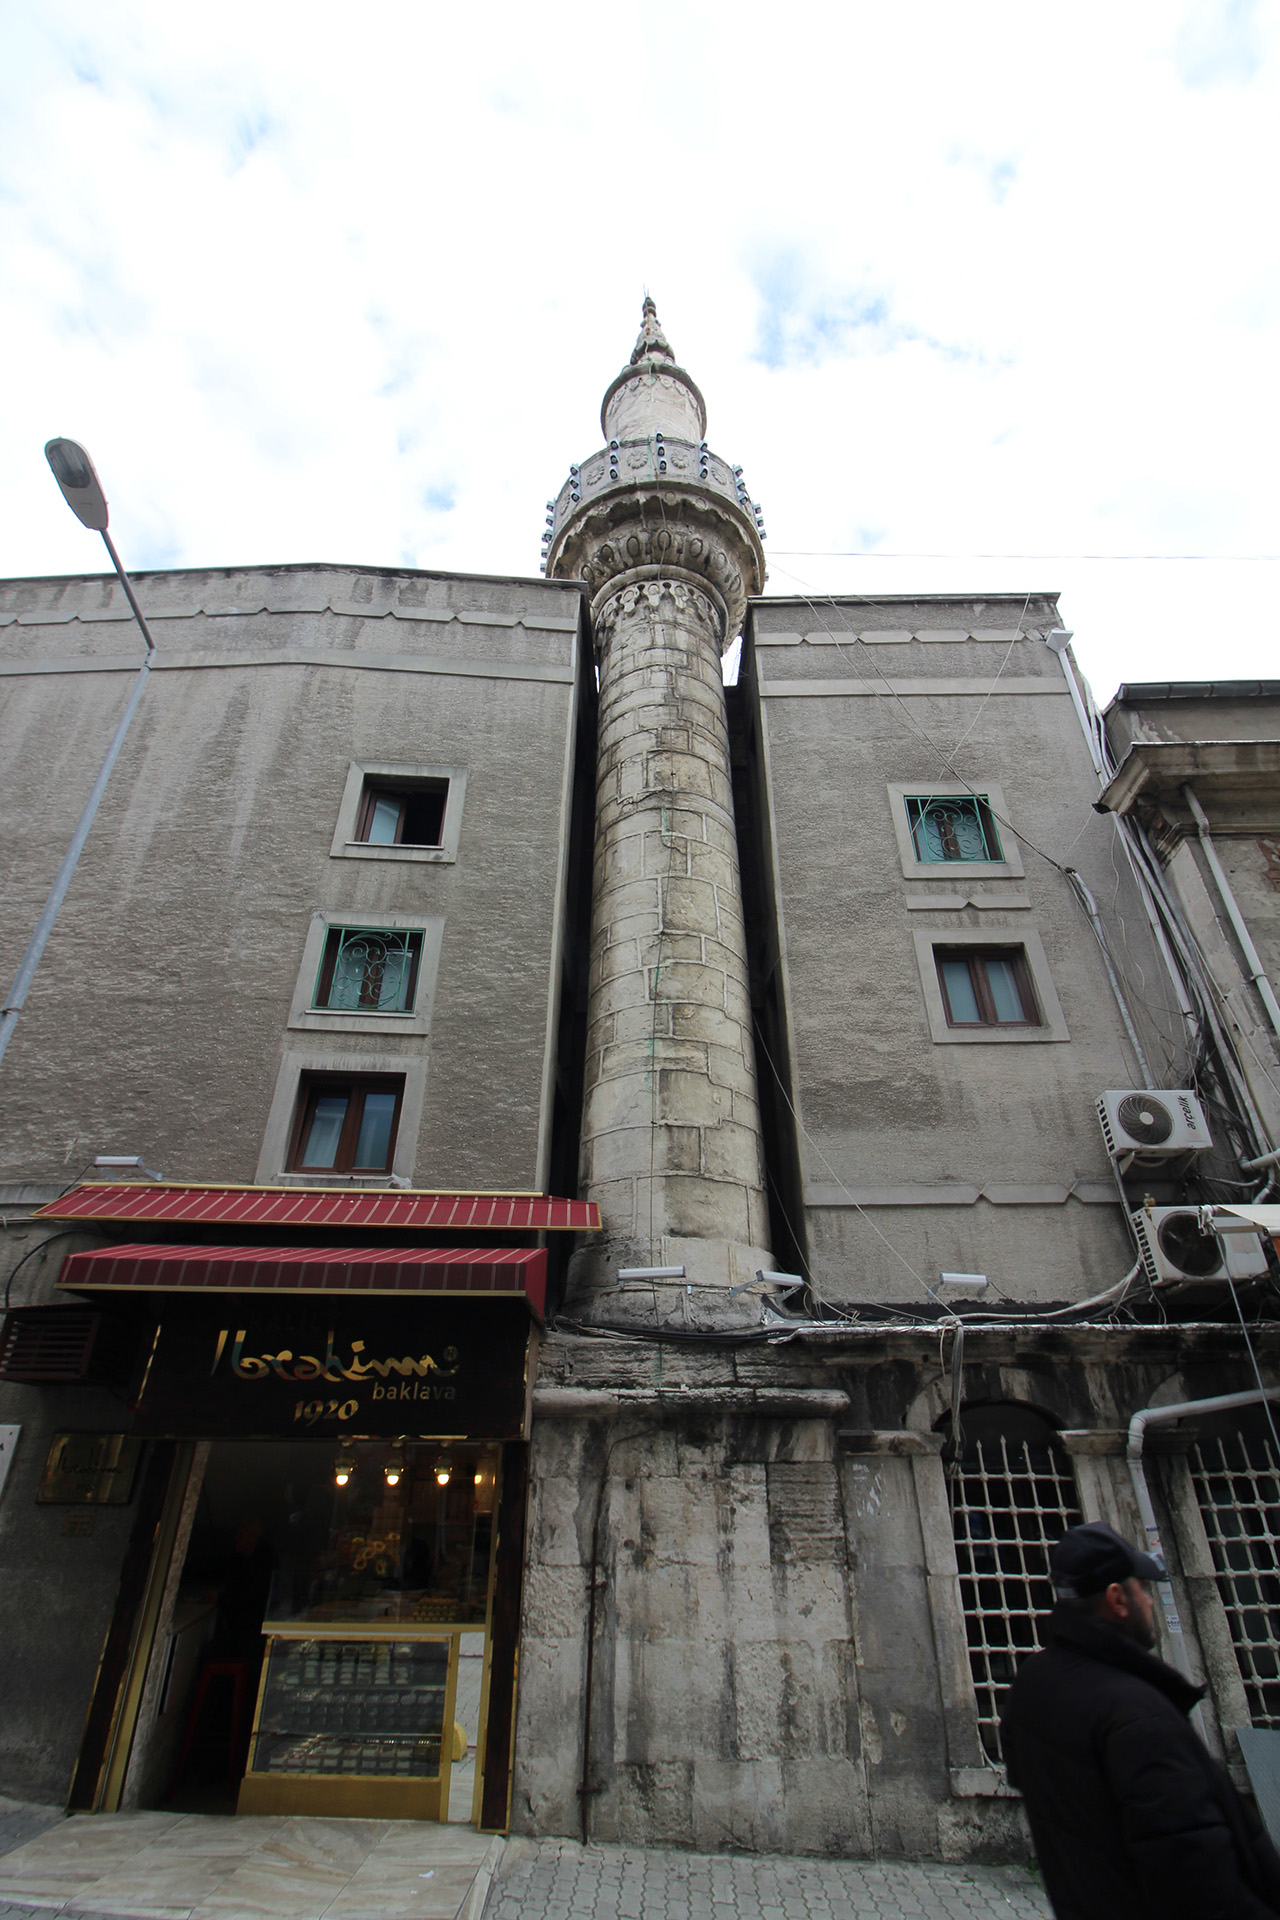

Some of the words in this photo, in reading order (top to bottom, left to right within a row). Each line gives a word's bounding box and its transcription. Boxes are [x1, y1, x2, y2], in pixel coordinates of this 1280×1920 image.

[1177, 1095, 1197, 1130] arçelik
[372, 1382, 457, 1401] baklava
[293, 1399, 360, 1427] 1920
